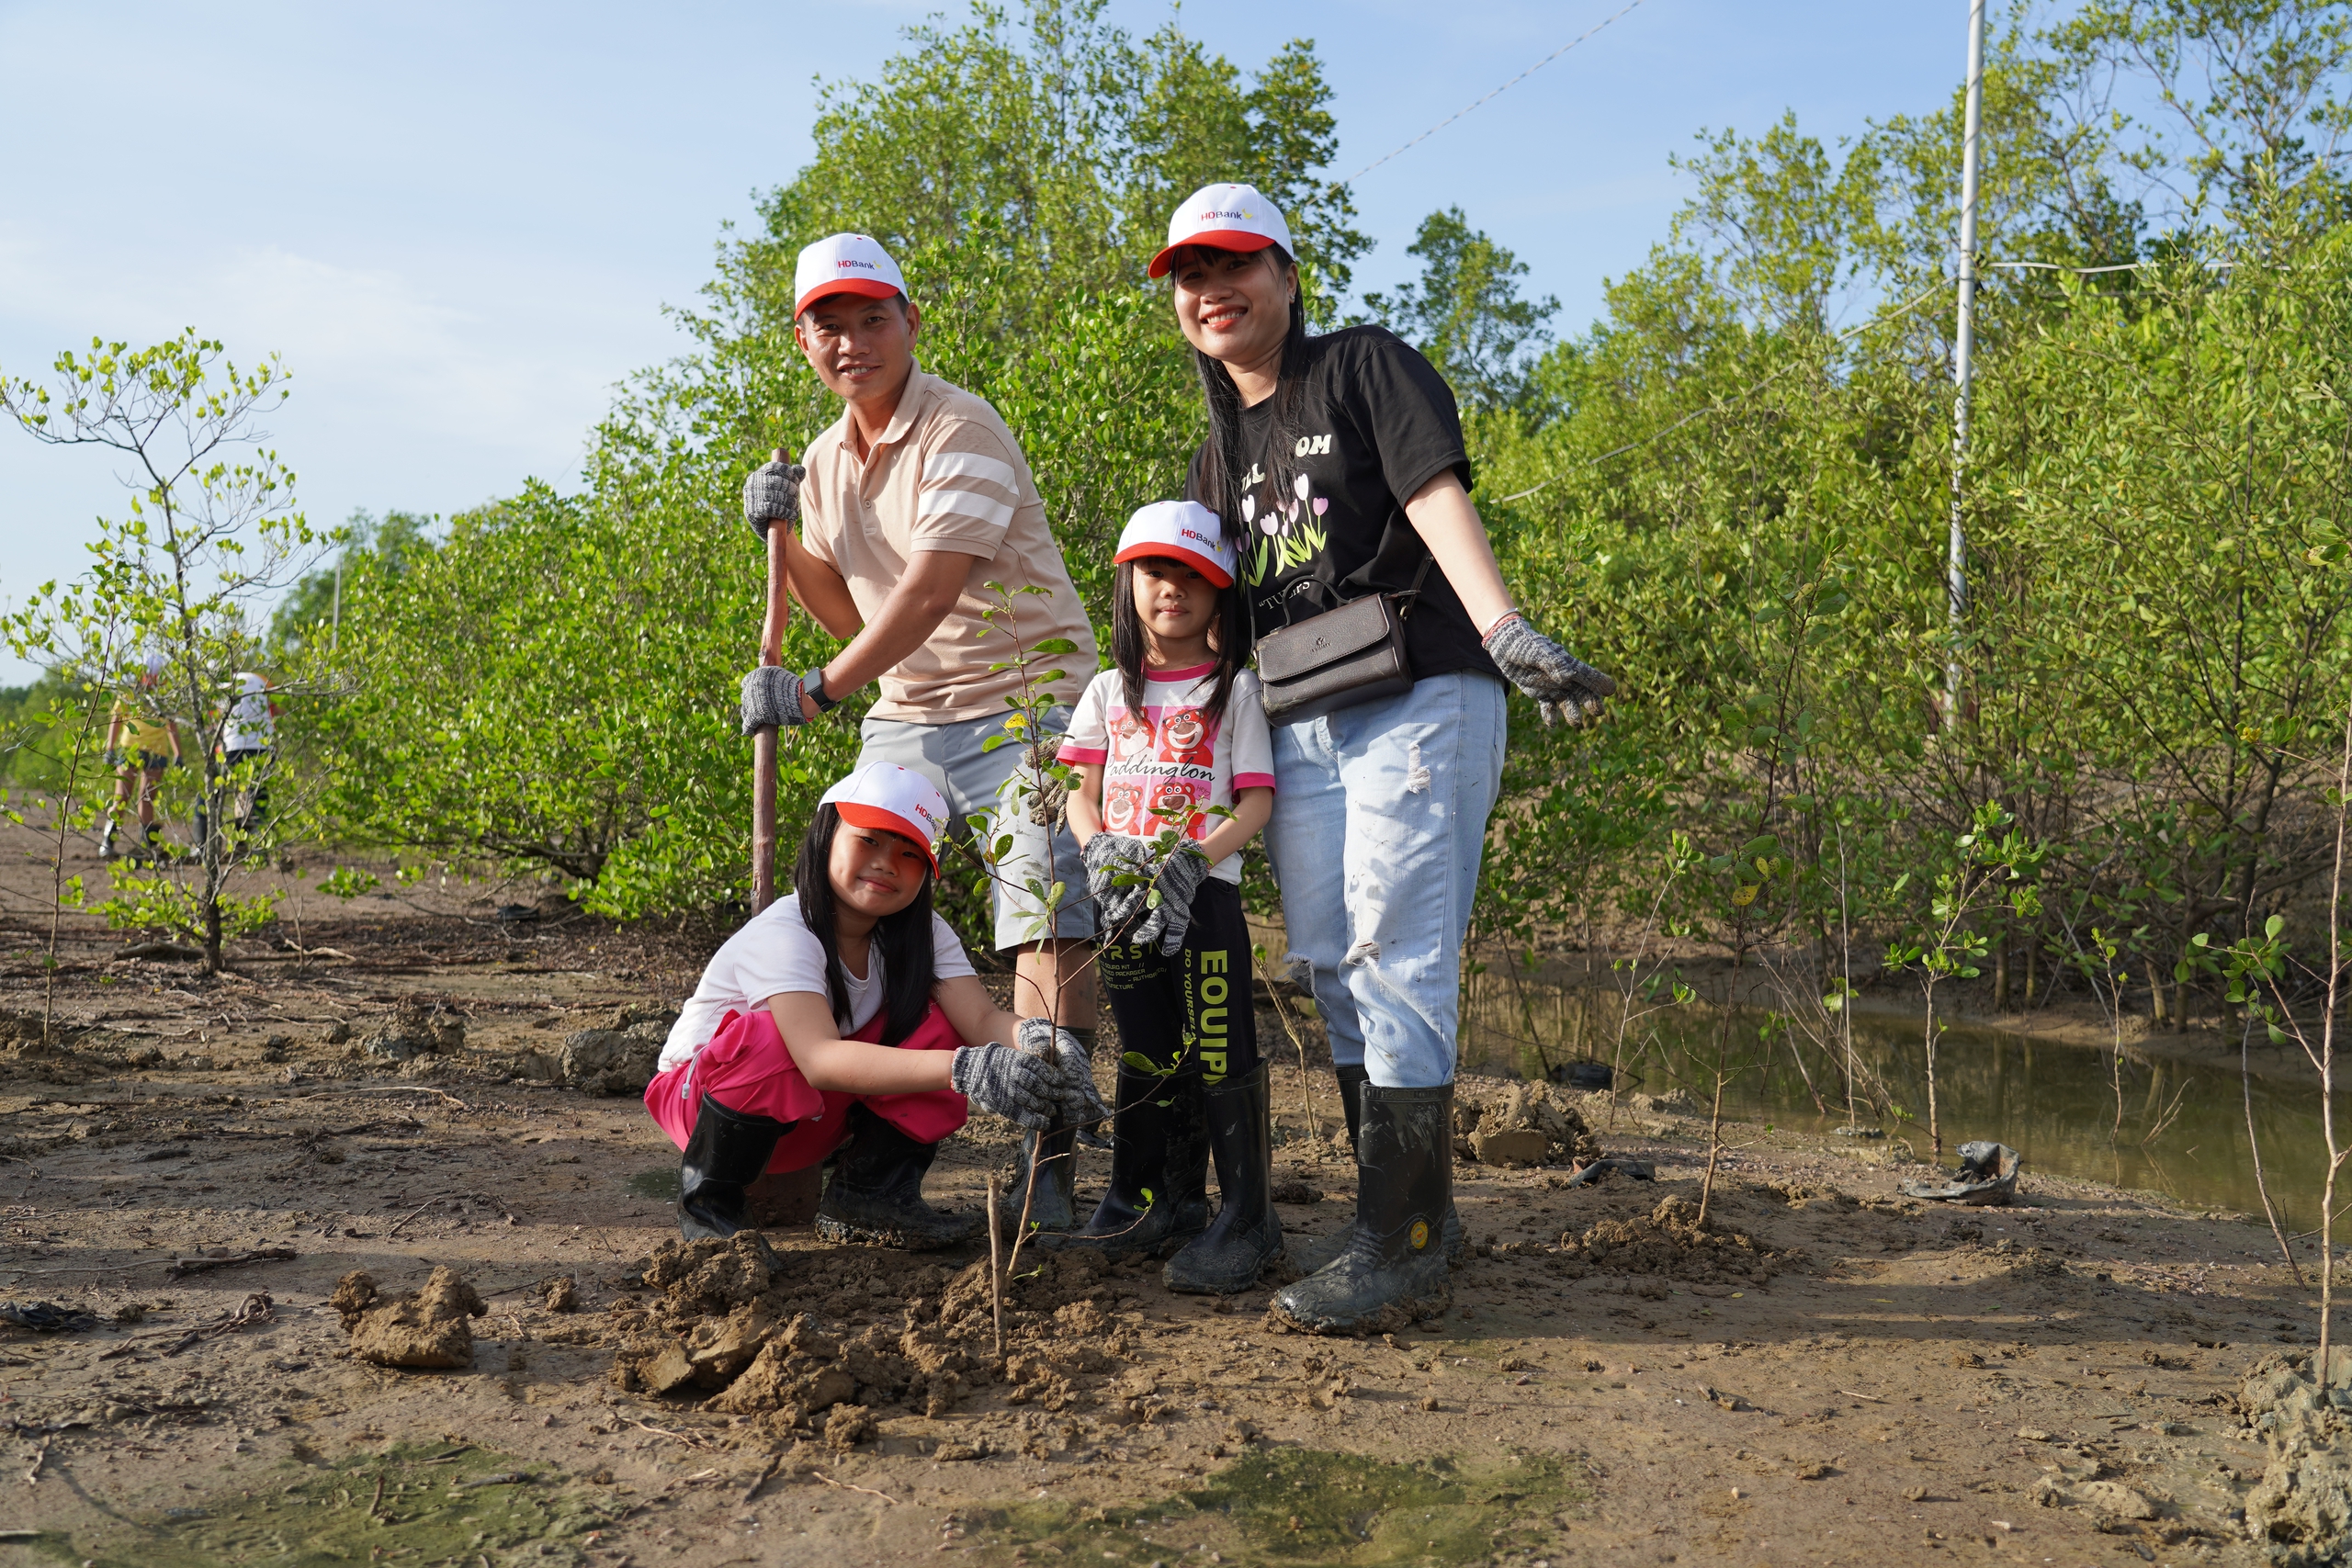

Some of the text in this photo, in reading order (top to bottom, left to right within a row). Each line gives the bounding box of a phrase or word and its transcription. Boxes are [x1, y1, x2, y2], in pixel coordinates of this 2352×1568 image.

[1201, 210, 1242, 221] HDBank
[837, 260, 876, 270] HDBank
[1181, 528, 1216, 552] HDBank
[1184, 948, 1192, 968] DO
